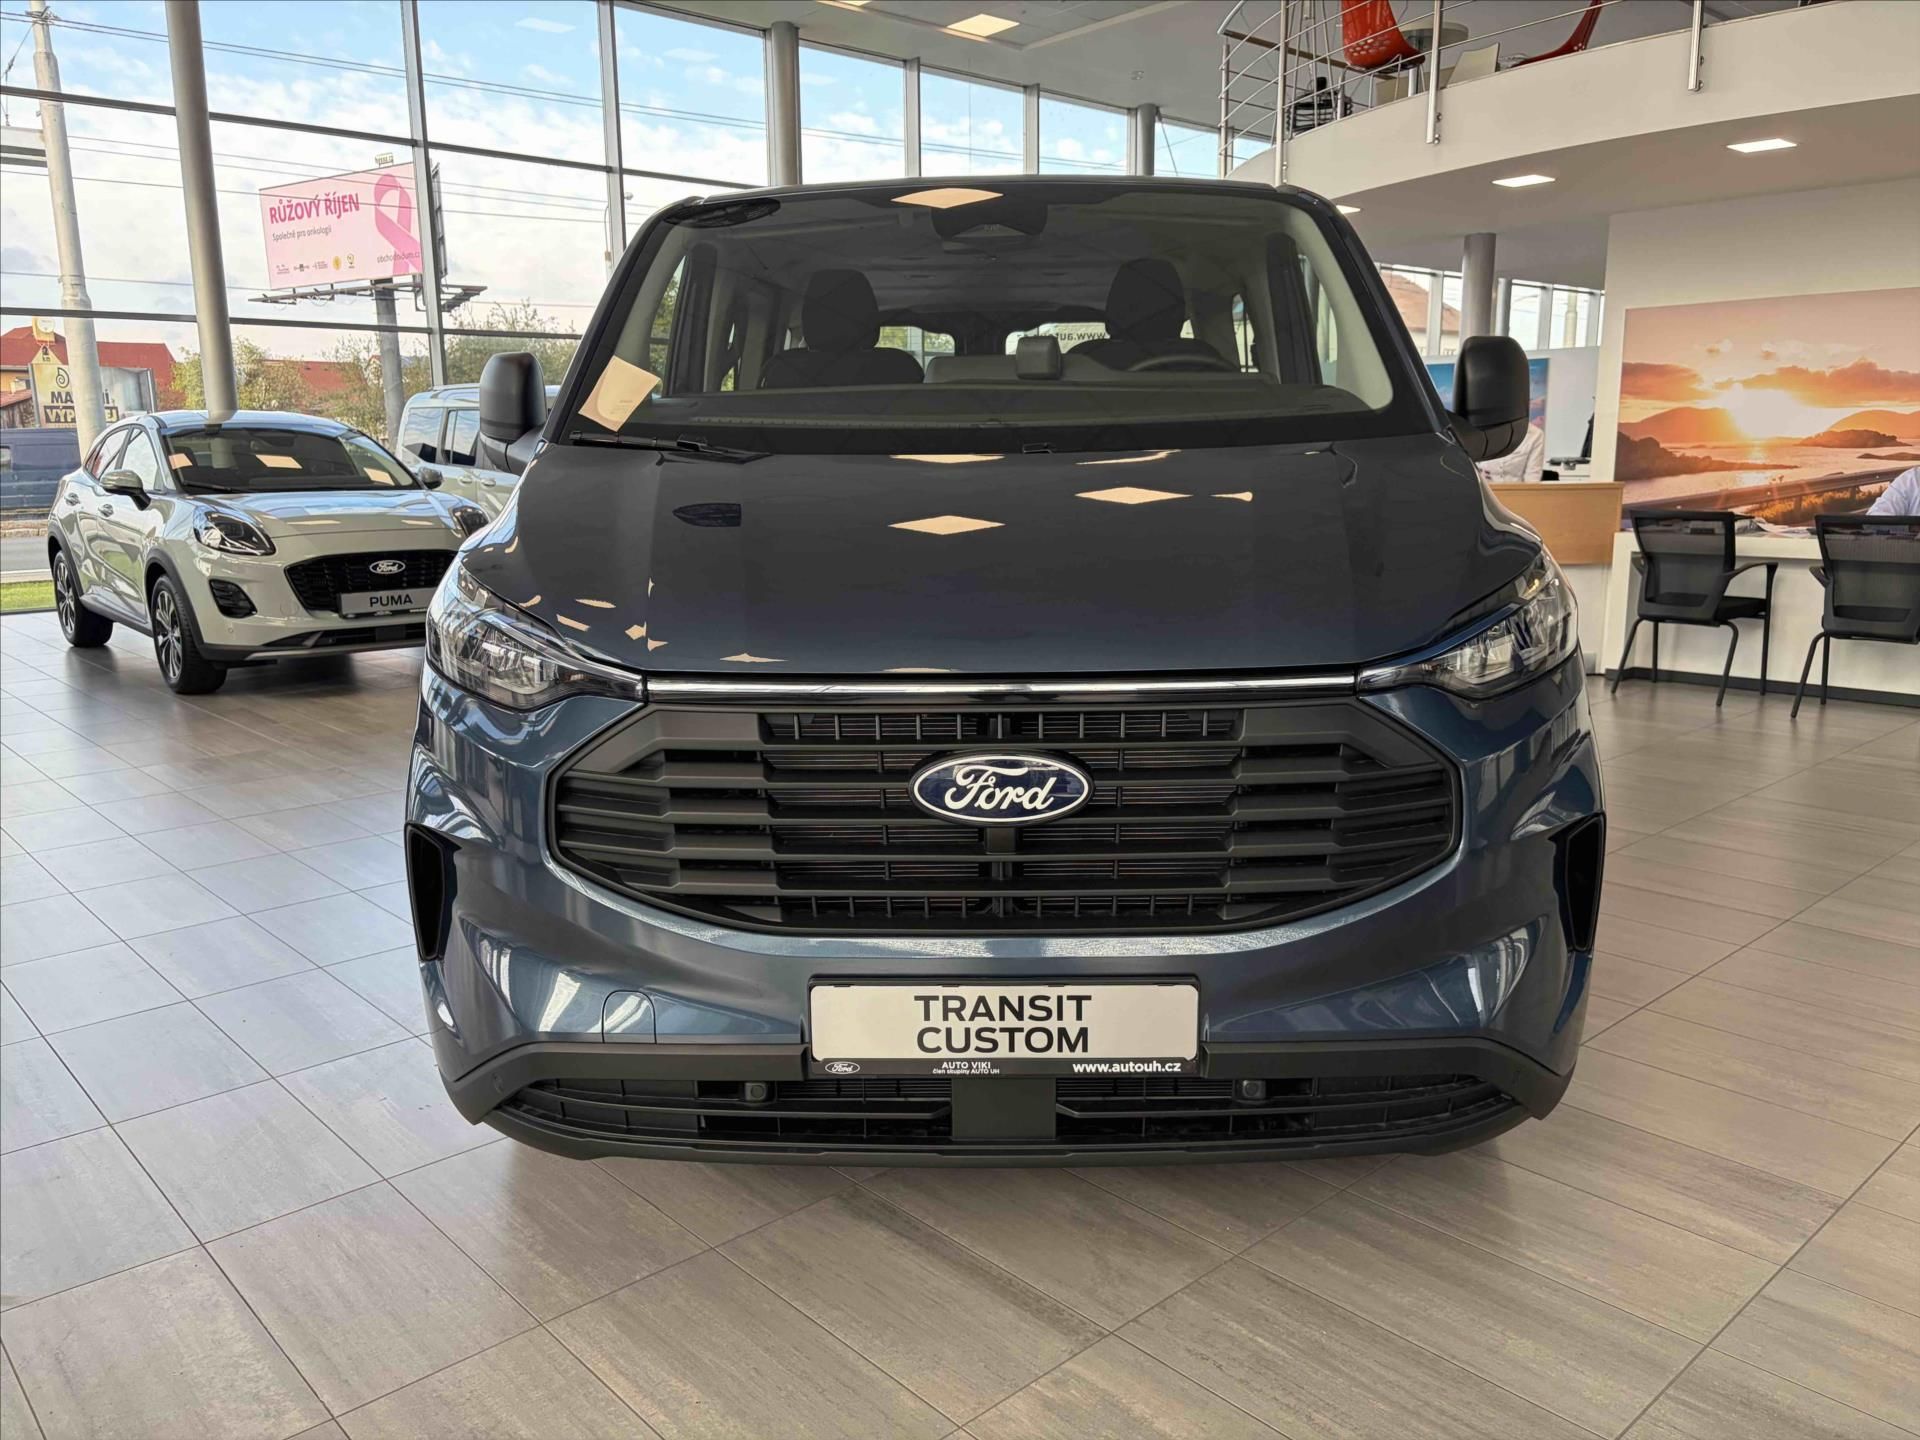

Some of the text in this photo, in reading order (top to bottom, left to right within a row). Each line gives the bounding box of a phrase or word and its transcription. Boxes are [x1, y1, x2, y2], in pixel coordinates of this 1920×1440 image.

[269, 191, 360, 224] RŮŽOVÝ ŘÍJEN
[297, 229, 306, 239] pro
[369, 593, 413, 607] PUMA
[944, 765, 1057, 810] Ford
[914, 995, 1092, 1022] TRANSIT
[917, 1026, 1089, 1053] CUSTOM
[942, 1061, 991, 1069] AUTO VIKI
[1072, 1060, 1181, 1073] www.autouh.cz
